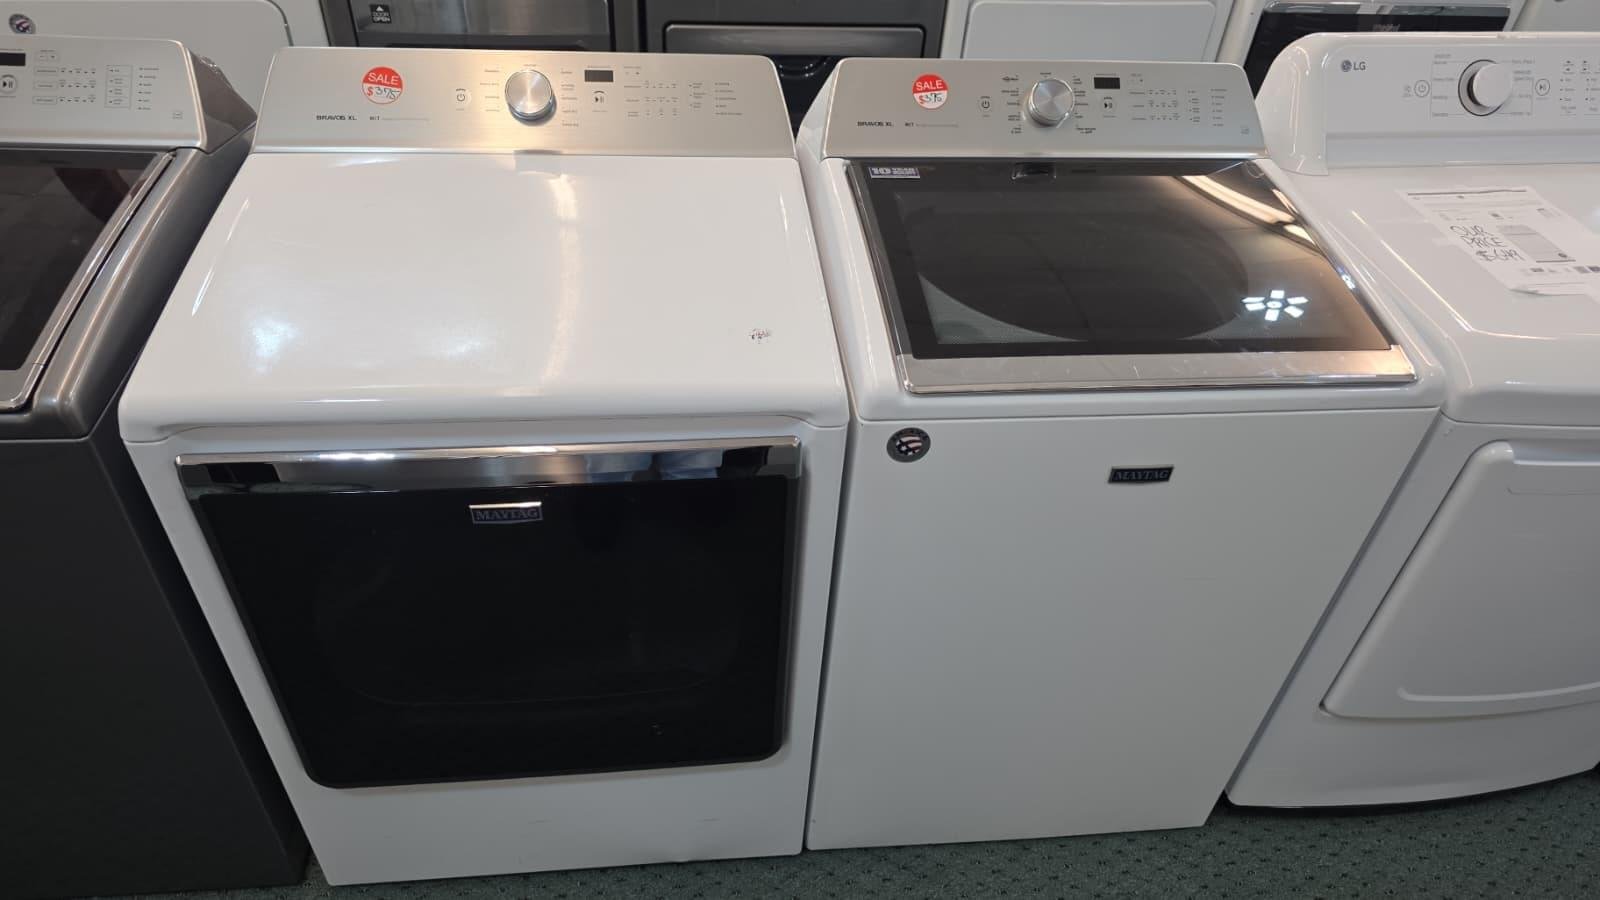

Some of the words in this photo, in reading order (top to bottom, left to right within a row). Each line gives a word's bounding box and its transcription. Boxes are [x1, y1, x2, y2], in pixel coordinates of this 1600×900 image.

[1353, 62, 1367, 71] LG
[368, 72, 400, 86] SALE
[915, 79, 944, 92] SALE
[1460, 236, 1508, 252] PRICE
[1112, 469, 1169, 481] MAYTAG
[476, 508, 538, 521] MAYTAG
